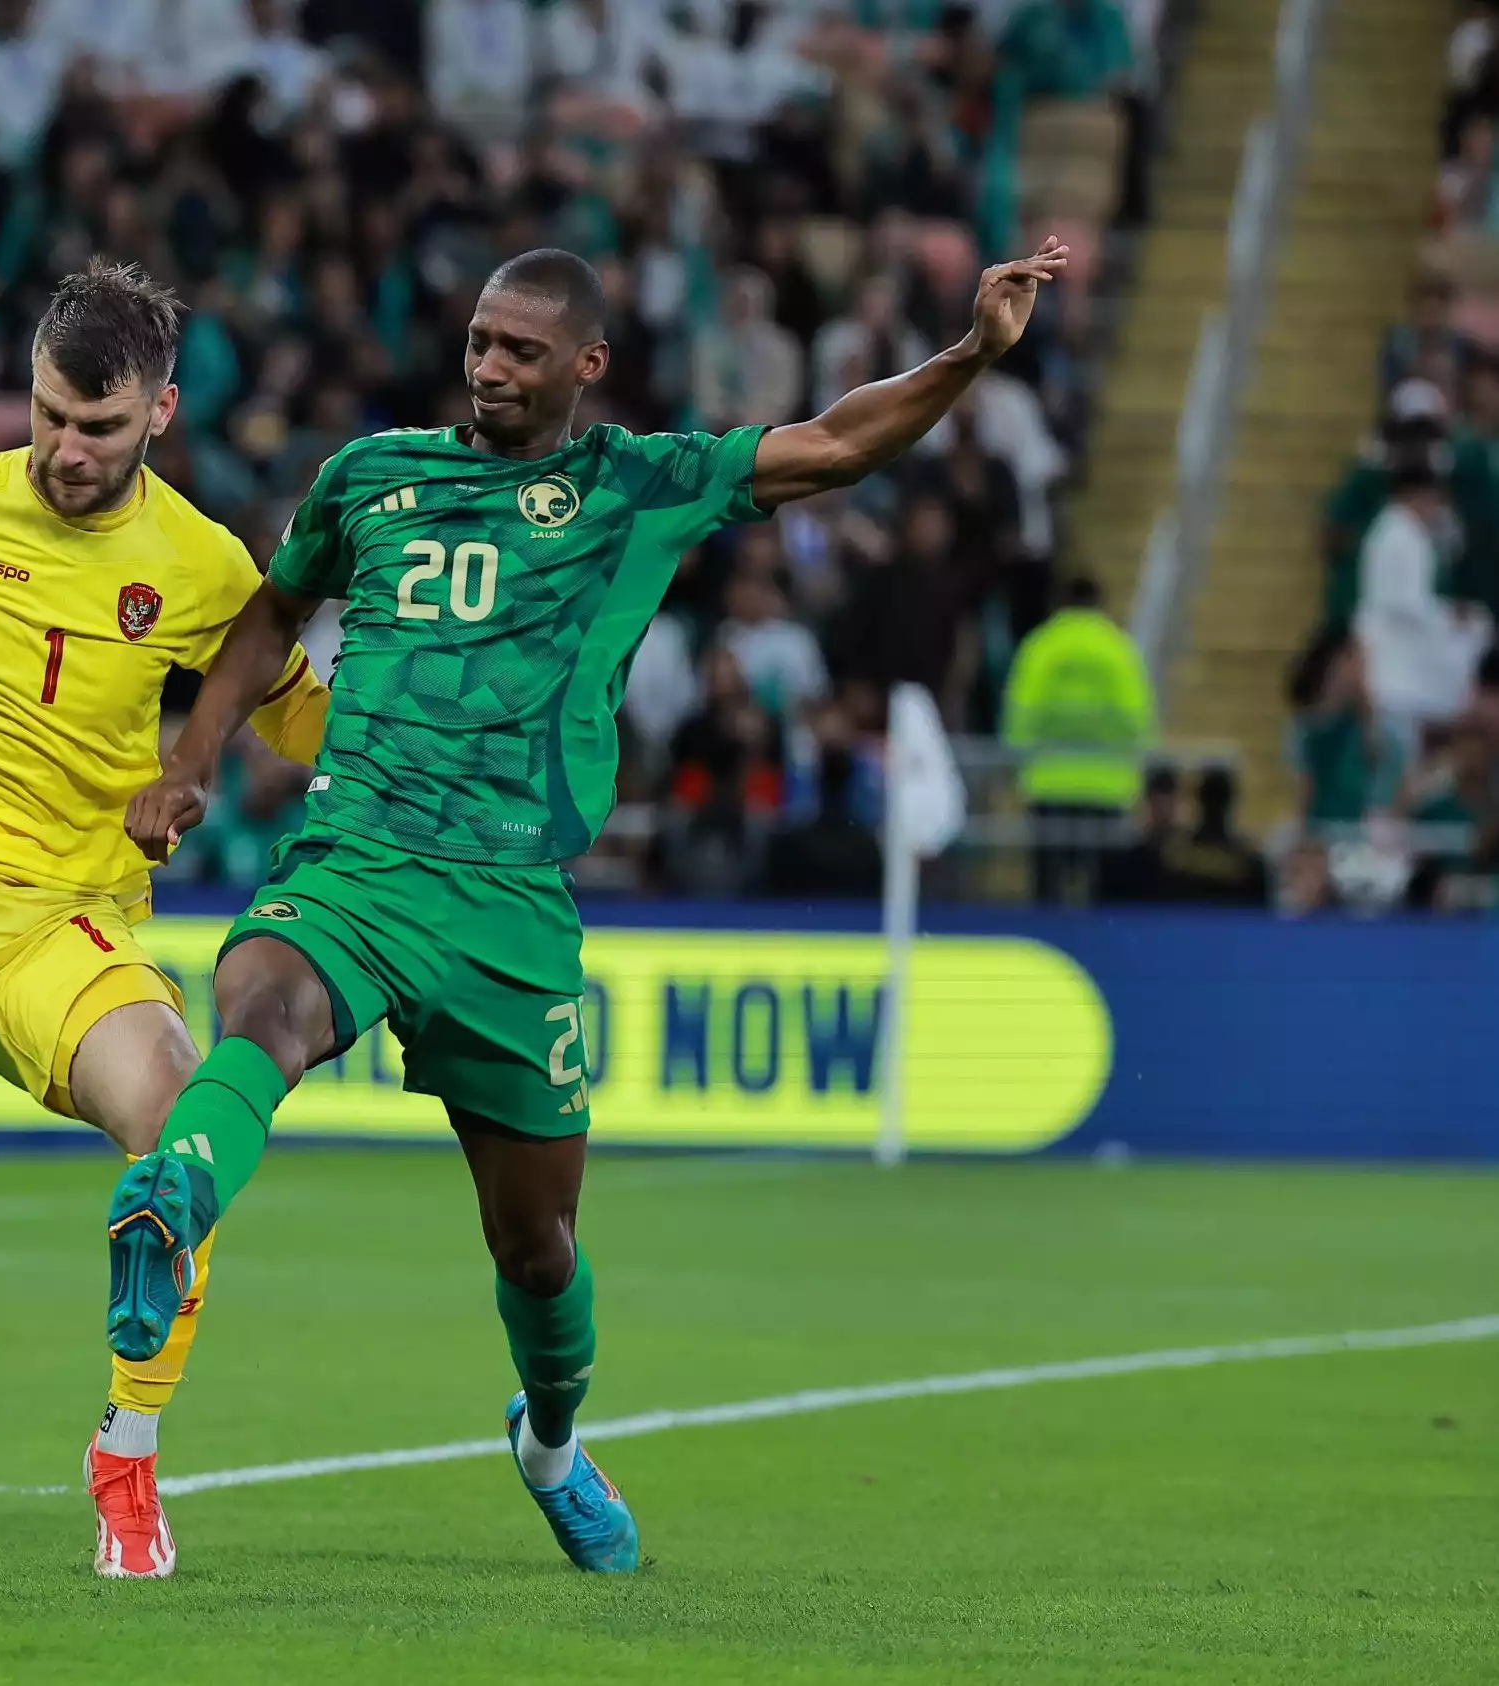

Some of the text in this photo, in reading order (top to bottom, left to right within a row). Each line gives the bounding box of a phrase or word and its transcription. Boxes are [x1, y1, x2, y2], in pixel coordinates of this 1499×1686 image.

[530, 530, 565, 539] SAUDI
[396, 540, 499, 622] 20
[40, 628, 65, 705] 1
[68, 914, 117, 953] 1
[660, 980, 890, 1093] NOW
